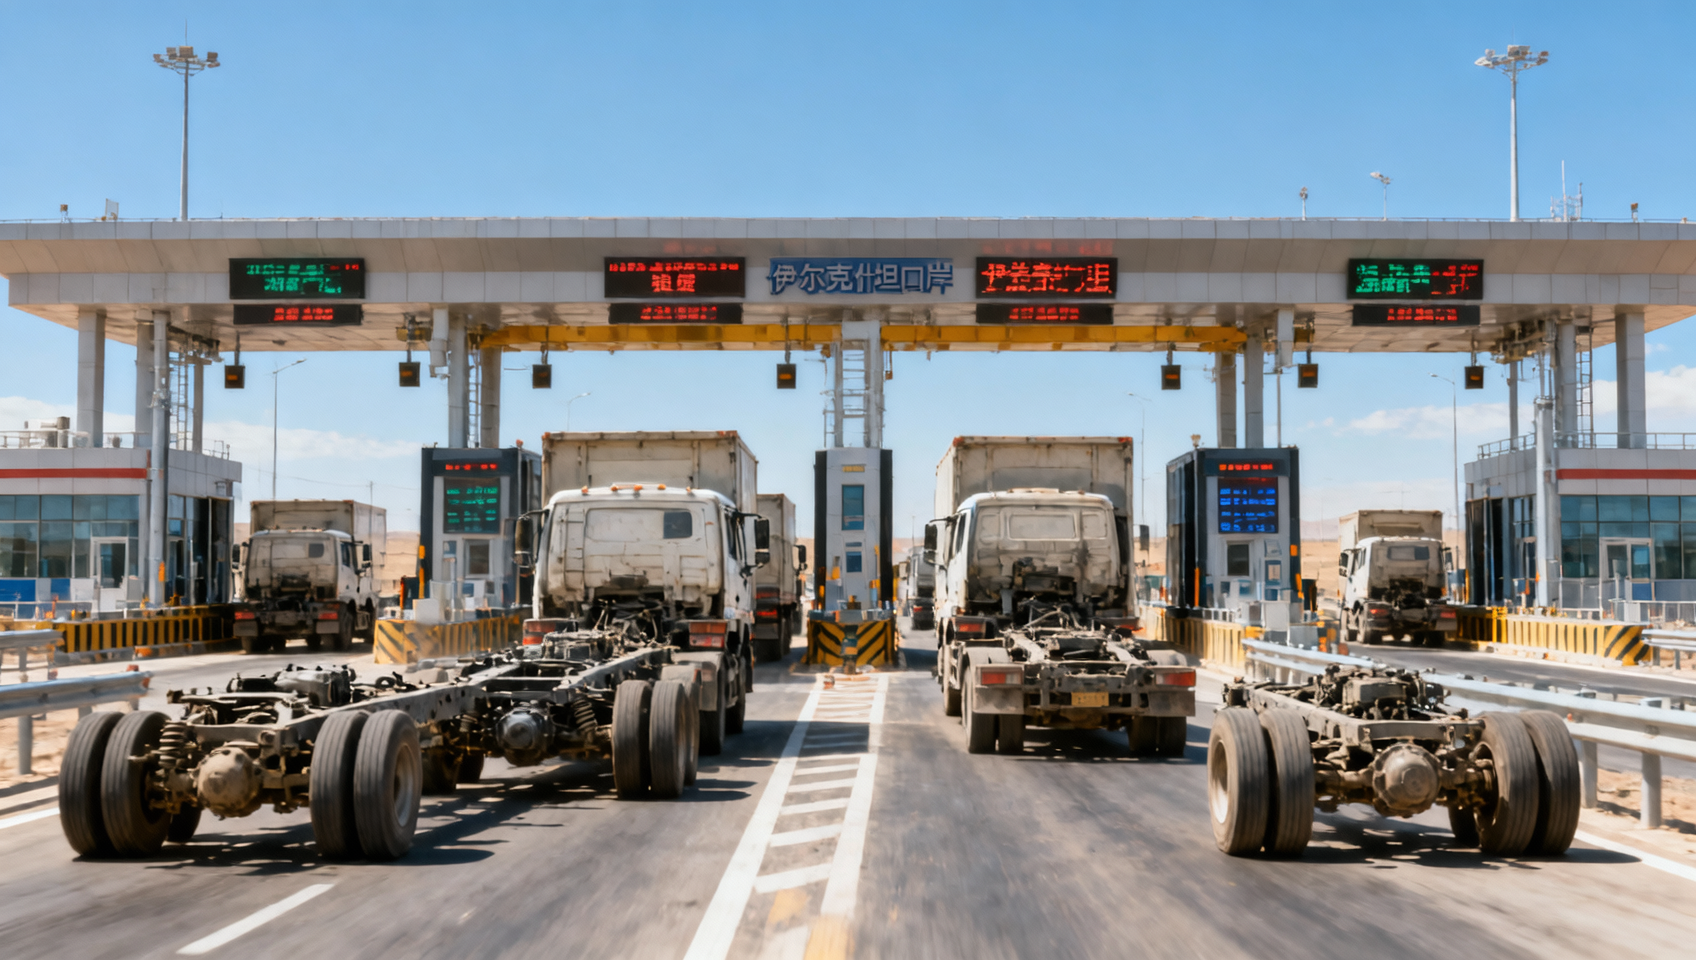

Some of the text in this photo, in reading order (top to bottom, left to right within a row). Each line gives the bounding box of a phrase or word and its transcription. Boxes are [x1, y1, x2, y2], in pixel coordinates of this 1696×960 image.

[772, 262, 953, 294] 伊尔克什坦口岸
